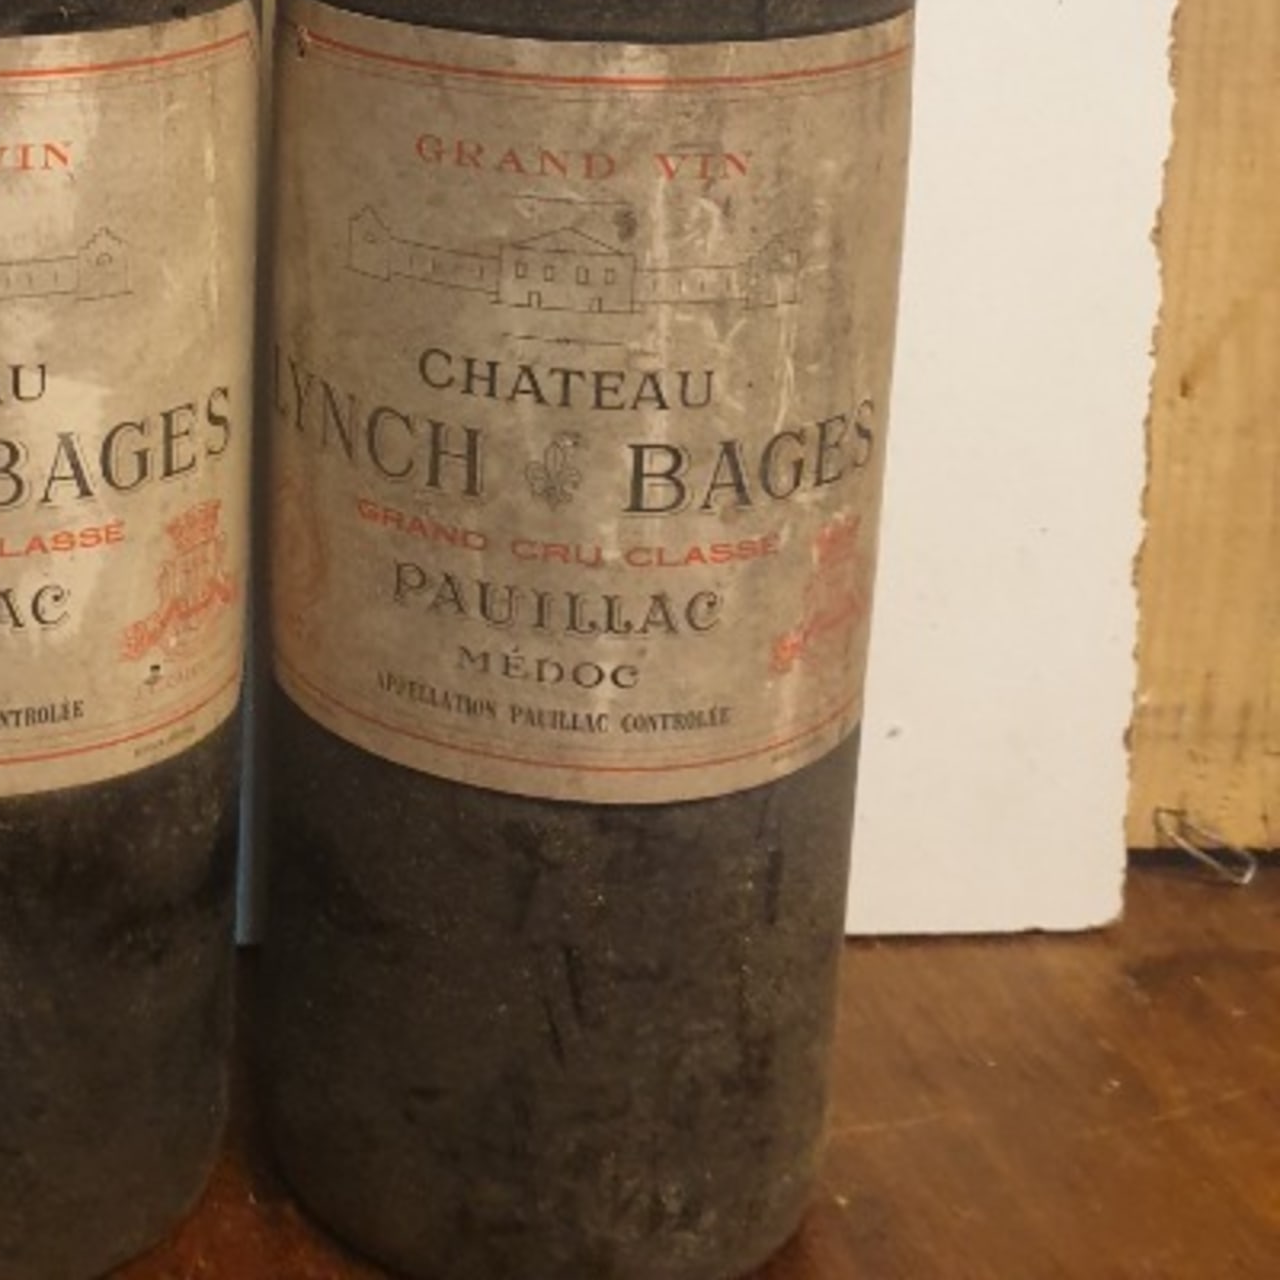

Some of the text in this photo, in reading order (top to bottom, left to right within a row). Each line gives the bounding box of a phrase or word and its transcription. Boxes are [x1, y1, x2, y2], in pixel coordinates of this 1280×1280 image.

[416, 133, 753, 180] GRAND VIN
[420, 349, 713, 411] CHATEAU
[273, 343, 875, 514] LYNCH BAGES
[358, 498, 487, 552] GRAND
[510, 539, 602, 567] CRU
[394, 562, 723, 634] PAUILLAC
[458, 644, 639, 689] MÉDOC
[376, 670, 496, 719] APPELLATION
[509, 704, 609, 733] PAUILLAC
